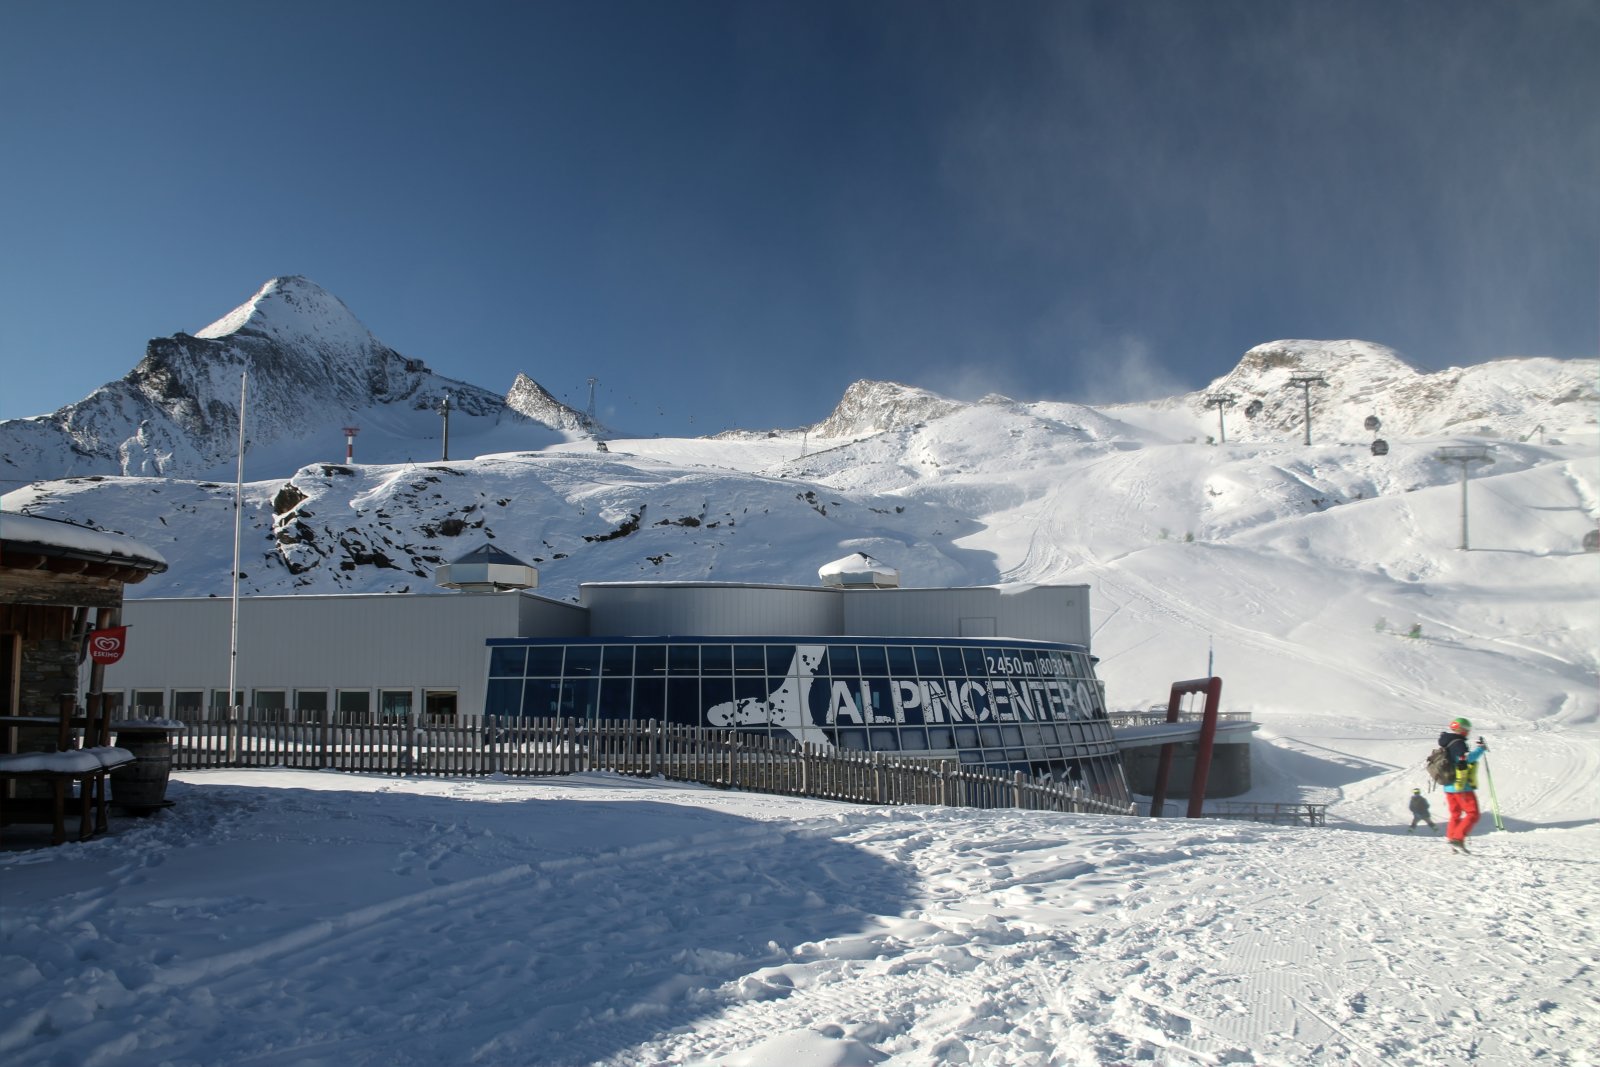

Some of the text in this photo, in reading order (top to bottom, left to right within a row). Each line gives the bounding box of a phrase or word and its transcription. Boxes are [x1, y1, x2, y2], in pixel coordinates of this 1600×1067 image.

[93, 650, 119, 658] ESKIMO
[987, 656, 1022, 674] 2450
[826, 680, 1075, 723] ALPINCENTER
